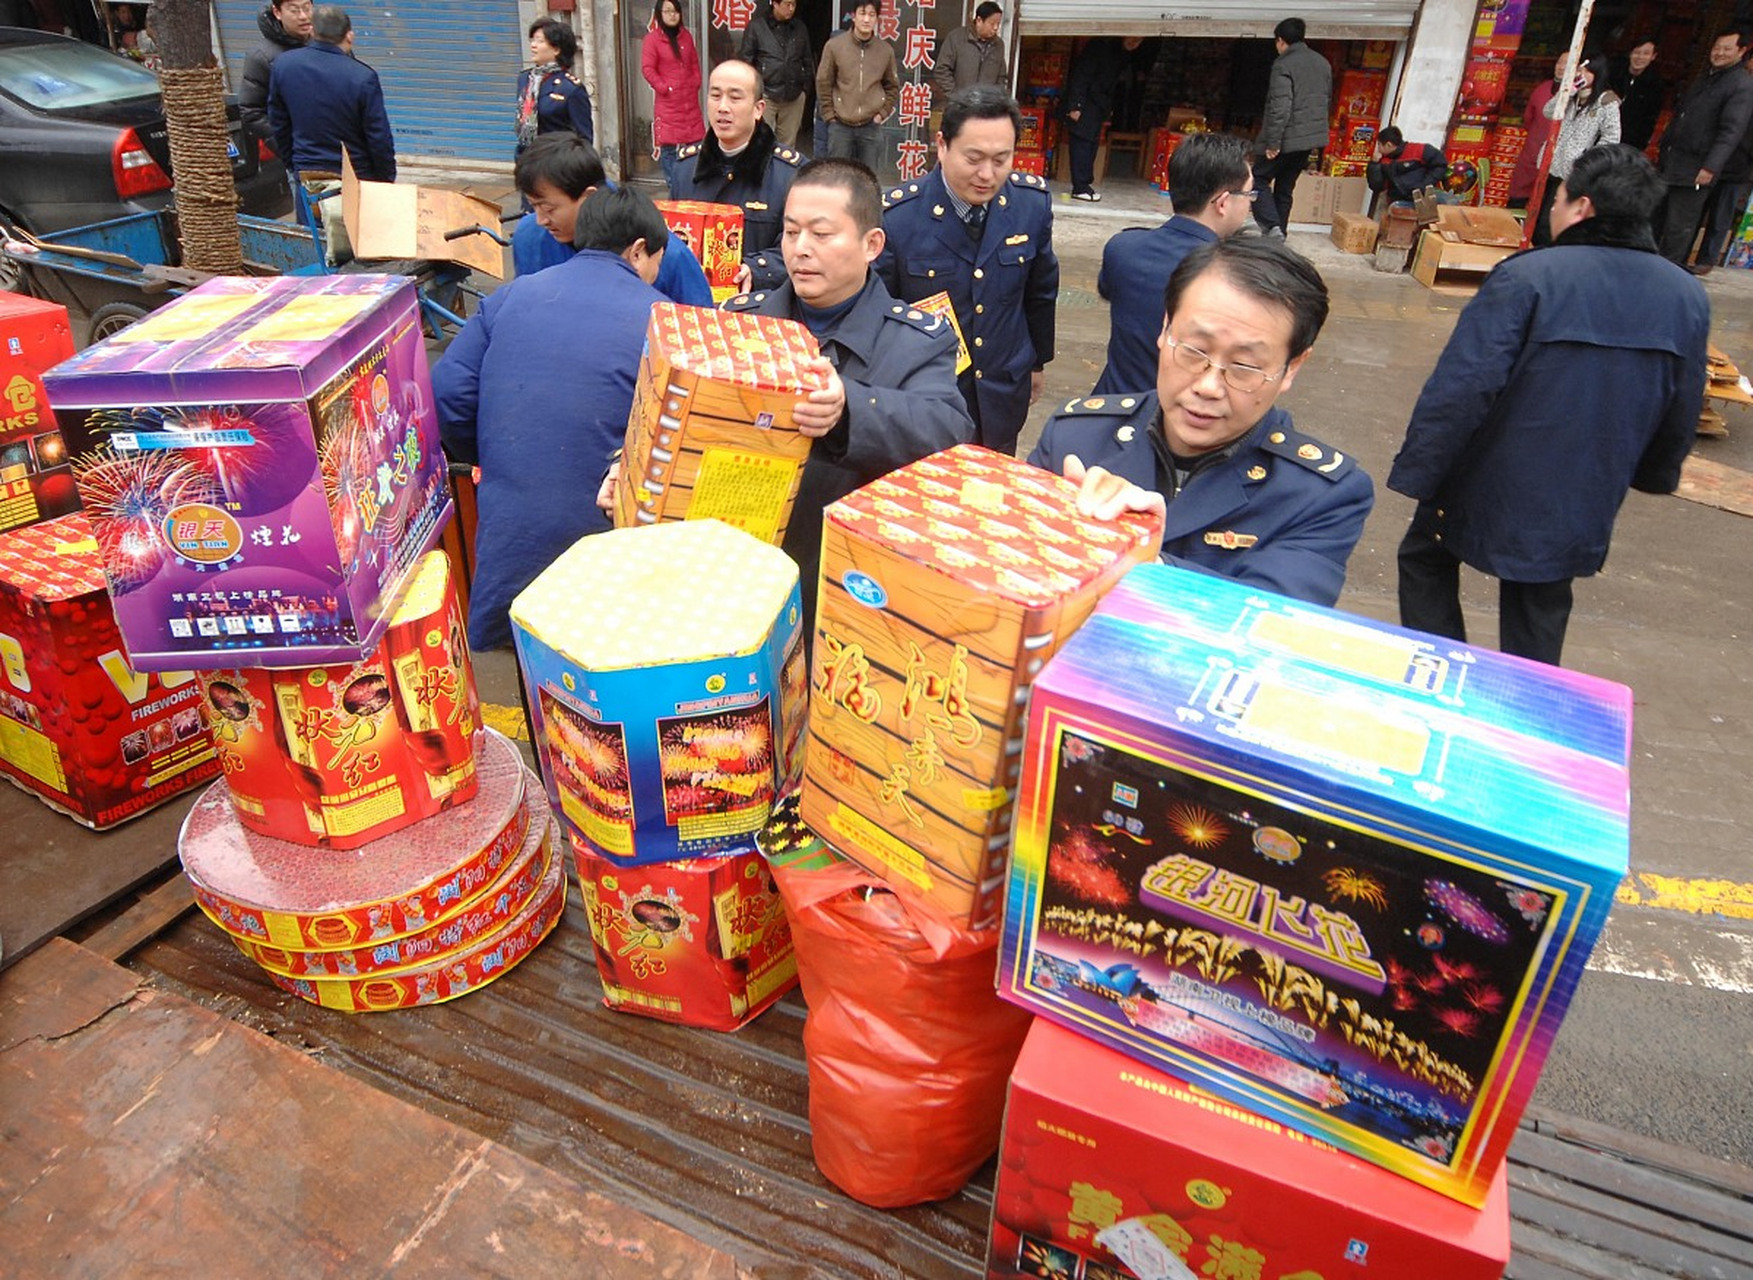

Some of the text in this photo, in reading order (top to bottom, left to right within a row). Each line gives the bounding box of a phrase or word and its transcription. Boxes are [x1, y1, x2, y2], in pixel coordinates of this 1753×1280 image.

[225, 502, 241, 511] TM
[178, 521, 225, 540] 银天
[131, 684, 200, 722] FIREWORKS
[97, 777, 184, 824] FIREWORKS
[1067, 1181, 1325, 1280] 黄金满
